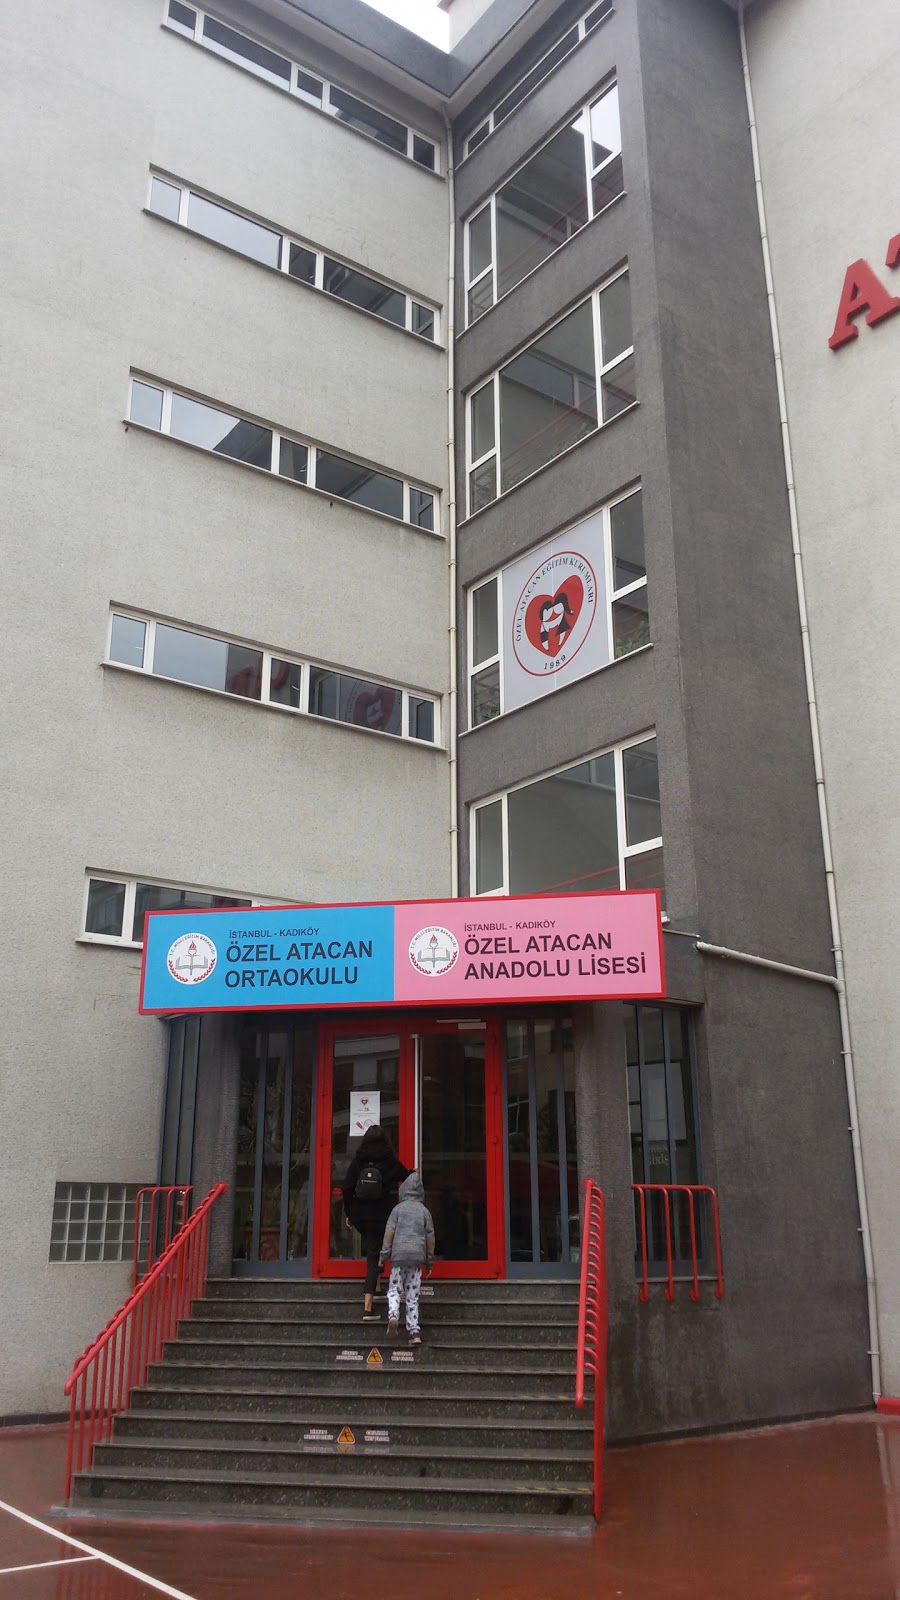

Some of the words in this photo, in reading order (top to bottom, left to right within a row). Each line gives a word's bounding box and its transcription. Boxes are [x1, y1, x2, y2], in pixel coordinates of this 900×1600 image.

[828, 233, 900, 352] A
[520, 575, 541, 612] ATACAN
[568, 558, 594, 604] KURUMLARI
[543, 654, 566, 670] 1989
[229, 929, 272, 939] İSTANBUL
[279, 927, 320, 937] KADIKÖY
[464, 922, 507, 932] İSTANBUL
[515, 920, 556, 930] KADIKÖY
[226, 942, 281, 963] ÖZEL
[286, 940, 373, 961] ATACAN
[464, 934, 520, 956] ÖZEL
[525, 932, 612, 953] ATACAN
[224, 966, 358, 988] ORTAOKULU
[464, 959, 570, 980] ANADOLU
[578, 951, 646, 976] LİSESİ
